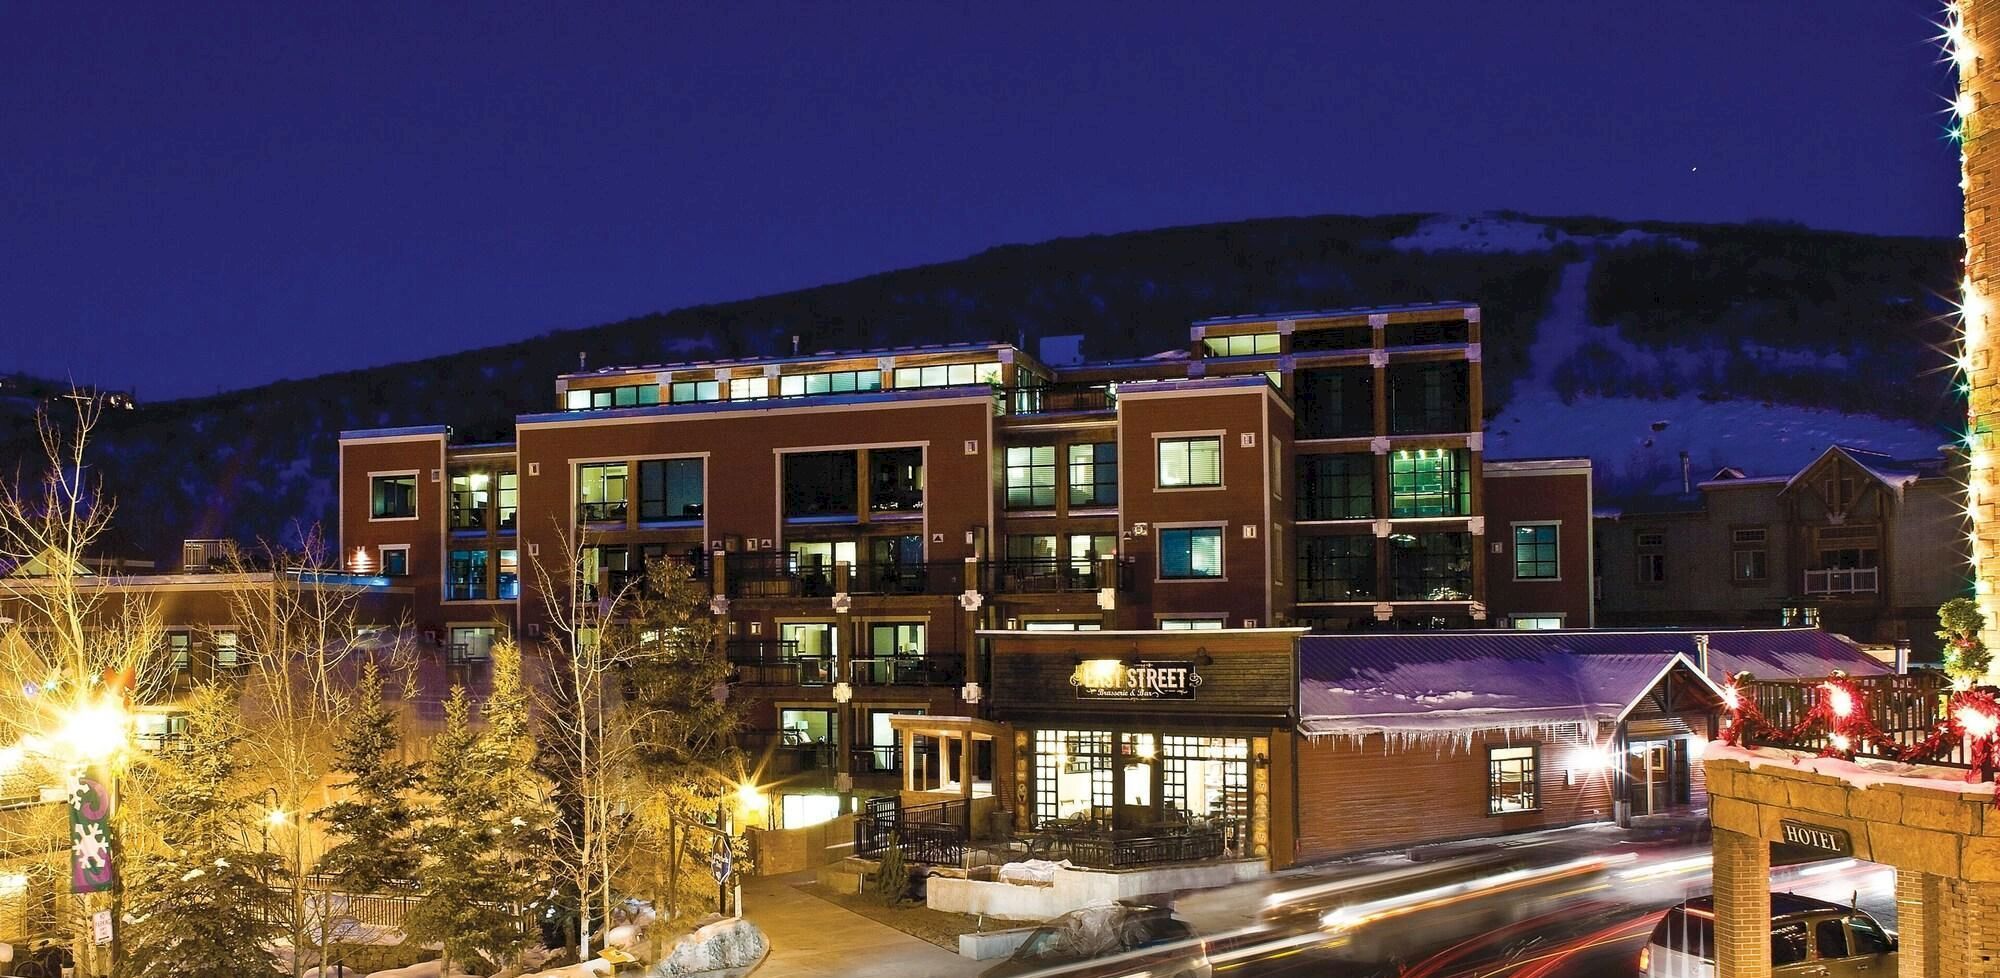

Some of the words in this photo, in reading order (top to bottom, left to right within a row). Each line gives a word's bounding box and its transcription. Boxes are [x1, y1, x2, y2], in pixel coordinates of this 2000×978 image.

[1097, 689, 1129, 697] Brasserie
[1130, 689, 1136, 697] &
[1137, 689, 1159, 698] Bar
[1127, 668, 1188, 694] STREET
[1785, 825, 1841, 852] HOTEL
